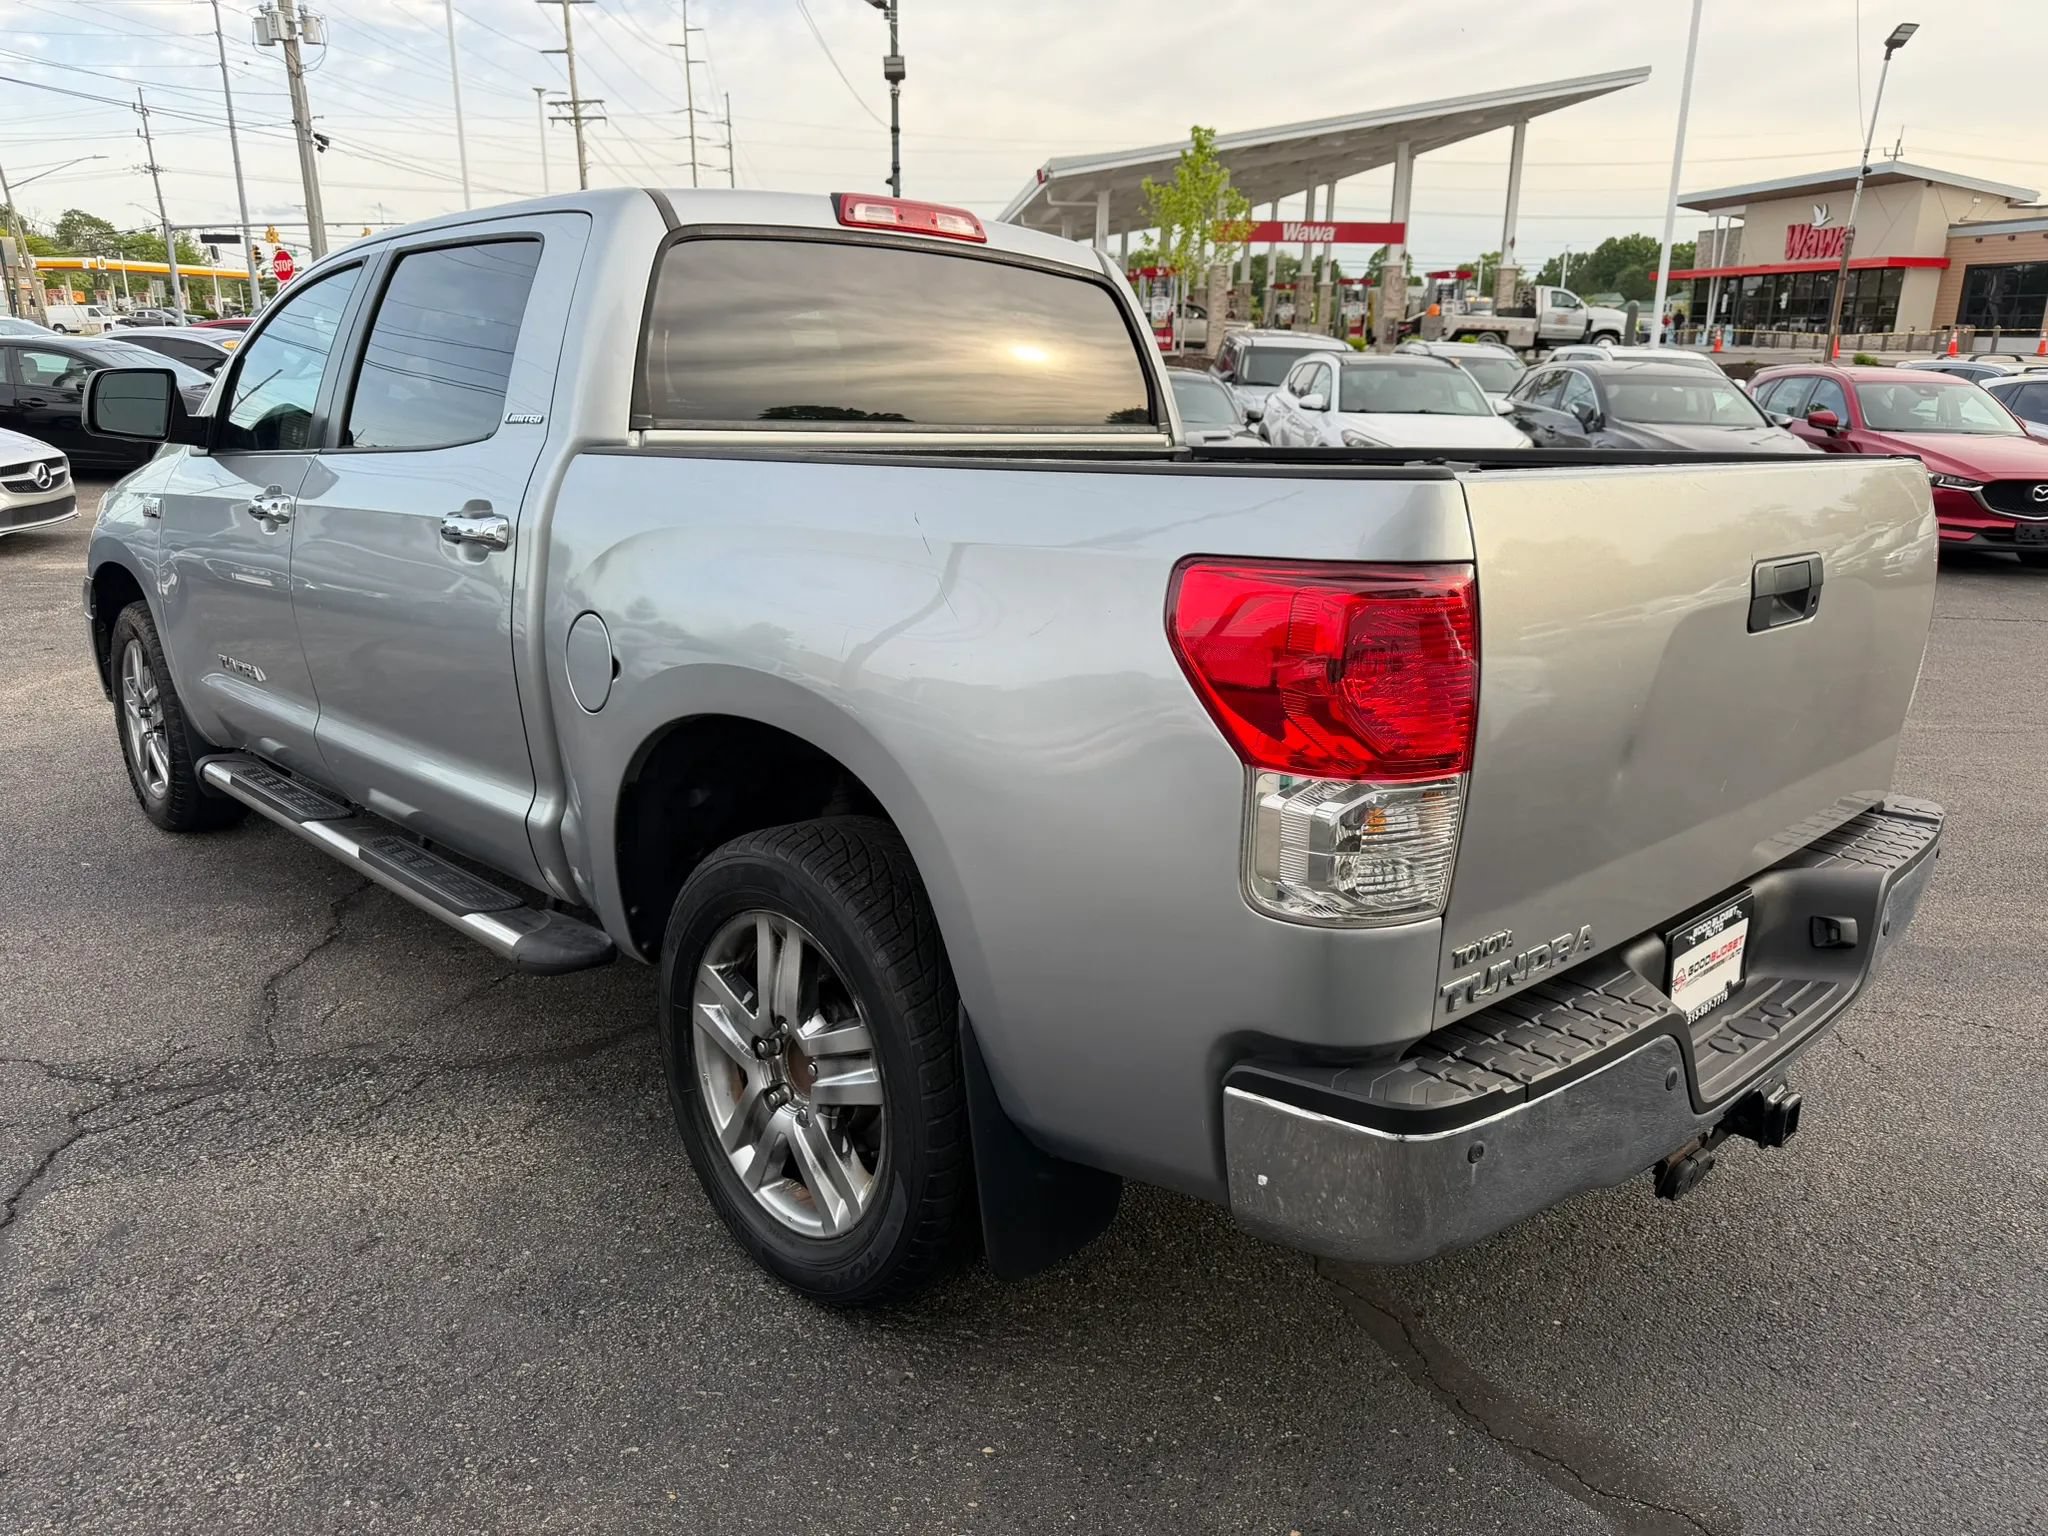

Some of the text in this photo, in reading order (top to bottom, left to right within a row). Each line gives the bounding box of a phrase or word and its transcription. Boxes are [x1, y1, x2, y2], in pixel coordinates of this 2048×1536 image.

[1282, 222, 1336, 241] Wawa
[274, 259, 293, 272] STOP
[1452, 928, 1513, 968] TOYOTA
[1440, 924, 1596, 1013] TUNDRA
